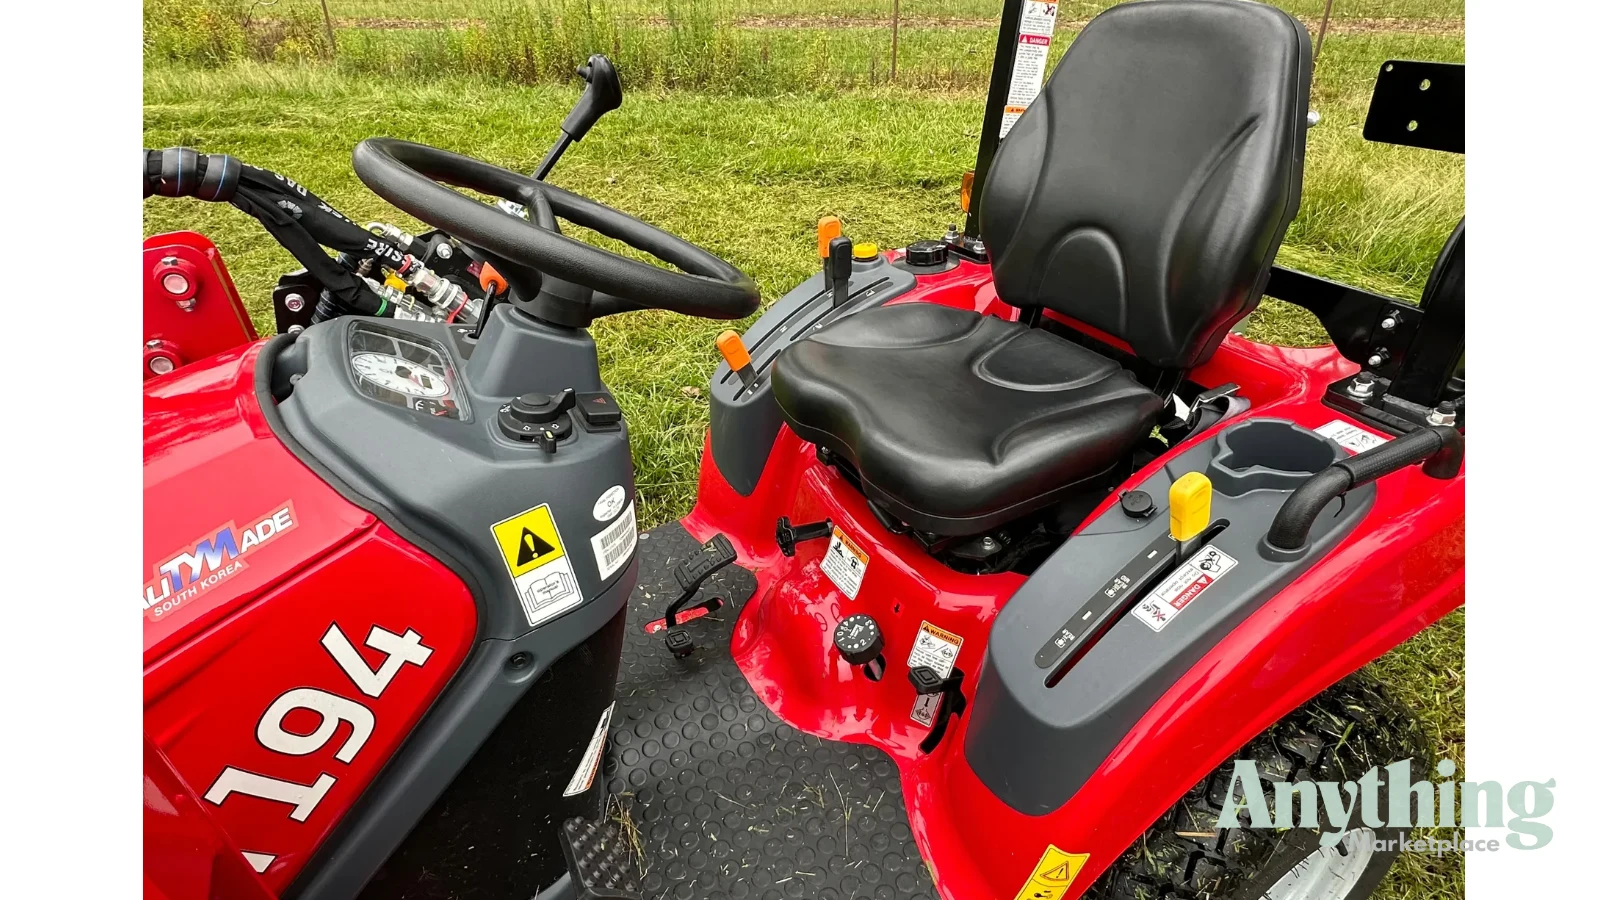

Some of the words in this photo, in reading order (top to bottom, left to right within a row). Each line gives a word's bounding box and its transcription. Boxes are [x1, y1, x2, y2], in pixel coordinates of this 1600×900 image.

[1029, 36, 1048, 45] DANGER
[845, 540, 862, 558] WARNING
[154, 587, 197, 617] SOUTH
[200, 560, 243, 590] KOREA
[1174, 583, 1201, 607] DANGER
[860, 638, 867, 646] 2
[930, 629, 960, 645] WARNING
[203, 620, 436, 874] 194
